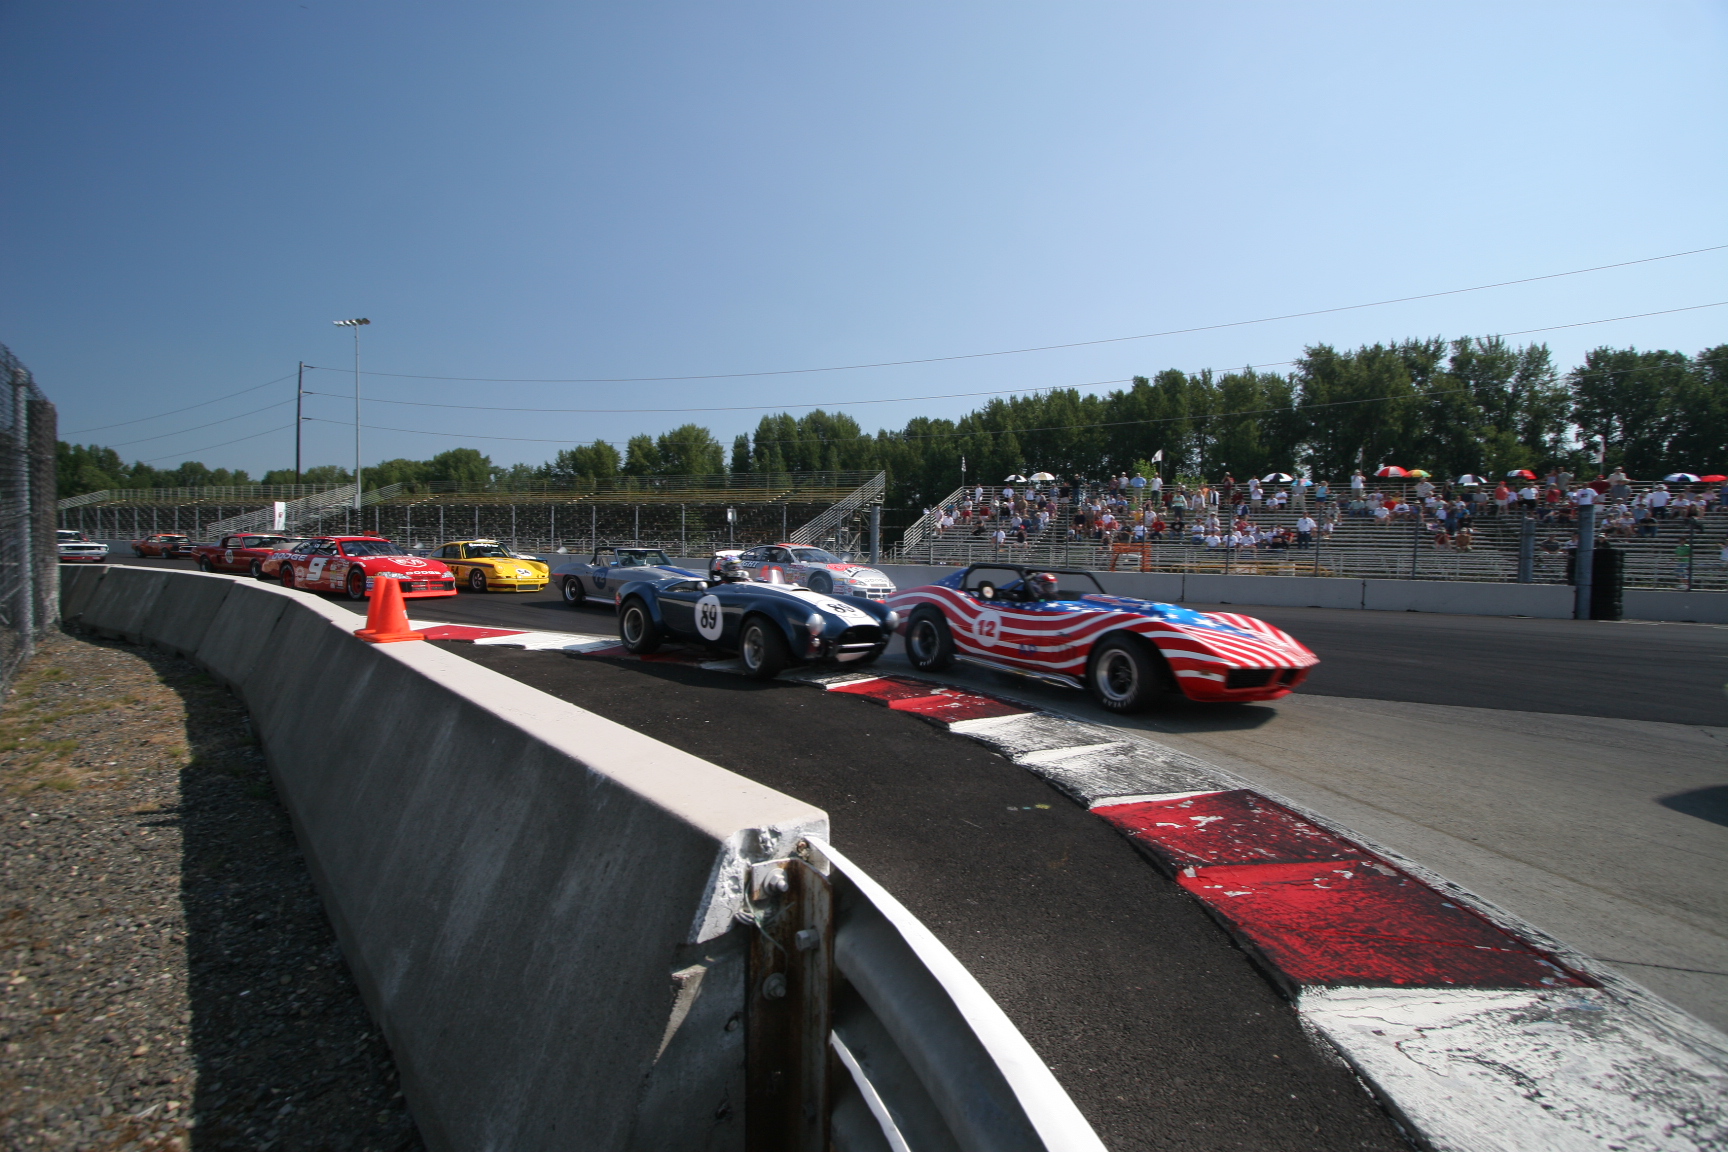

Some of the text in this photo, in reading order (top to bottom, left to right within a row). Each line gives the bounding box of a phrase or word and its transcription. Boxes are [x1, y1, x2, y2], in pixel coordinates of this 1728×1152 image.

[271, 552, 309, 562] DODGE
[306, 556, 329, 581] 9
[700, 603, 717, 630] 89
[826, 603, 855, 614] 89
[977, 619, 998, 638] 12
